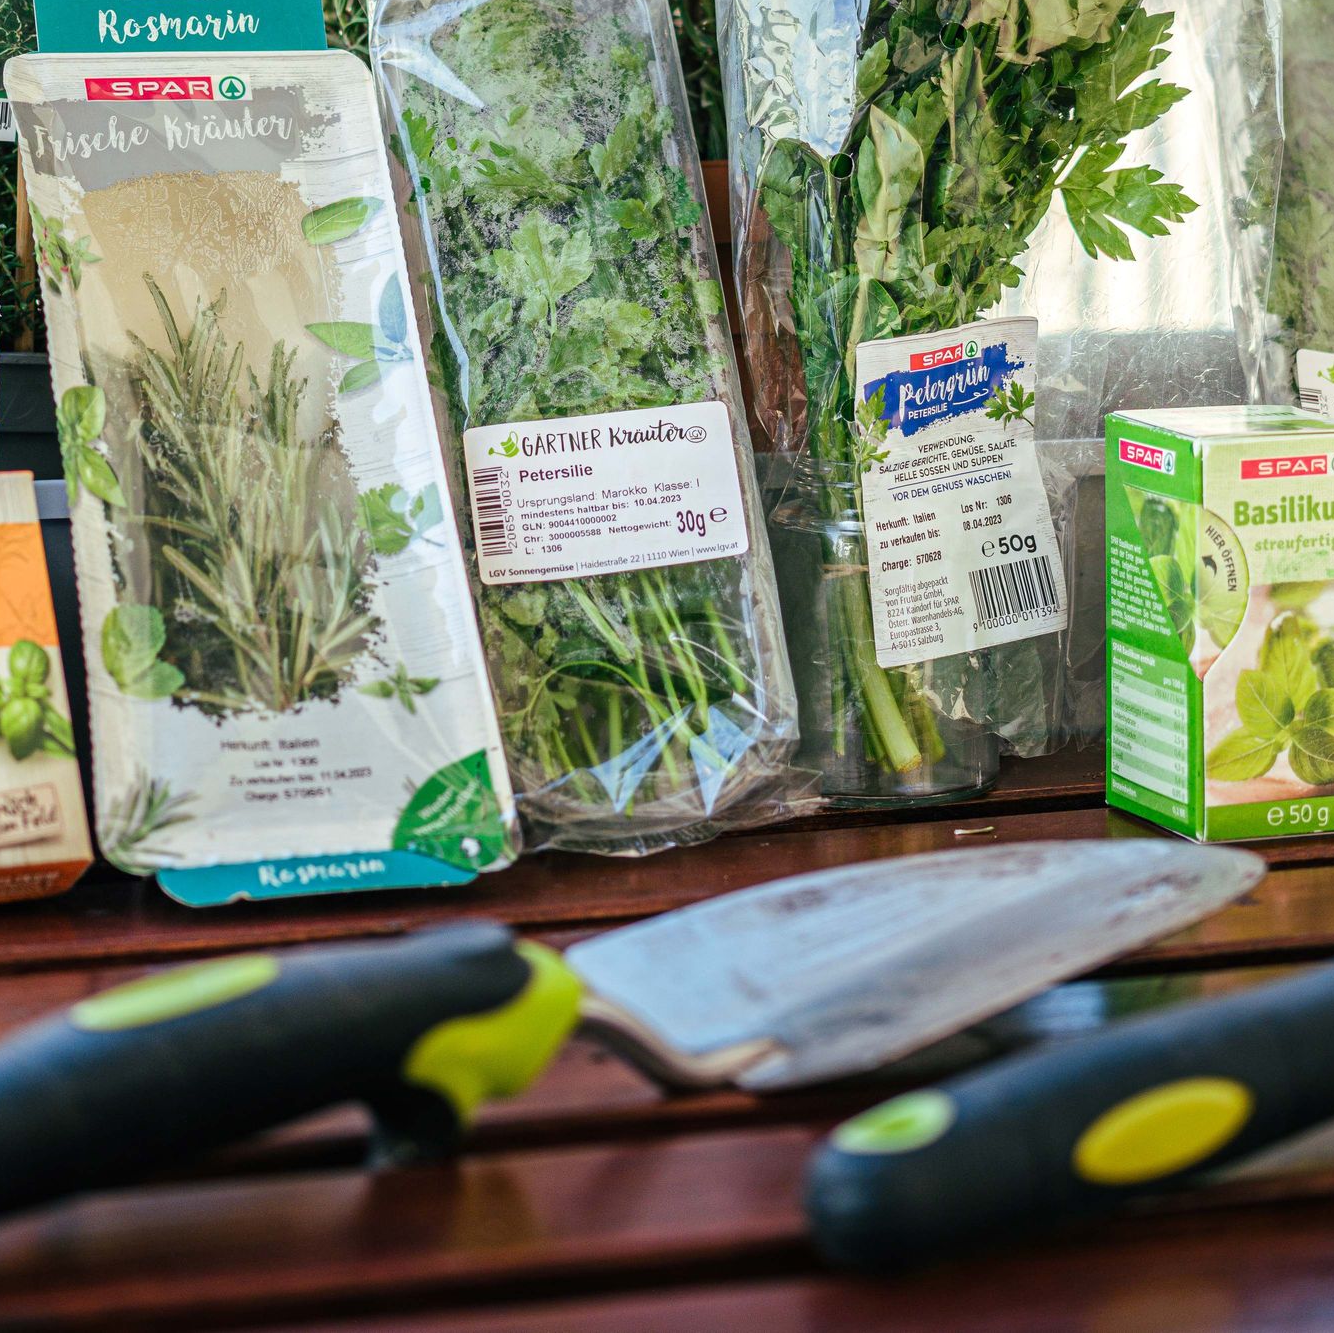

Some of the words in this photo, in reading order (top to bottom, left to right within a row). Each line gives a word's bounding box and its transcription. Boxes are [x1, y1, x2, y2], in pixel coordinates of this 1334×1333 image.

[98, 8, 260, 44] Rosmarin
[111, 80, 211, 97] SPAR
[33, 115, 149, 162] Frische
[163, 106, 293, 151] Kräuter
[922, 346, 962, 366] SPAR
[899, 361, 992, 423] Petergrün
[908, 402, 948, 421] PETERSILIE
[521, 428, 602, 457] GÄRTNER
[608, 419, 688, 448] Kräuter
[917, 434, 976, 454] VERWENDUNG:
[879, 460, 910, 474] SALZIGE
[911, 452, 950, 469] GERICHTE,
[951, 444, 986, 461] GEMÜSE,
[987, 438, 1017, 452] SALATE,
[1126, 445, 1163, 467] SPAR
[519, 464, 593, 483] Petersilie
[894, 470, 918, 483] HELLE
[919, 464, 951, 478] SOSSEN
[952, 460, 969, 471] UND
[970, 454, 1004, 468] SUPPEN
[1257, 458, 1327, 476] SPAR
[517, 491, 598, 509] Ursprungsland:
[601, 486, 648, 500] Marokko
[654, 480, 693, 493] Klasse:
[892, 489, 909, 502] VOR
[911, 485, 929, 497] DEM
[931, 479, 964, 494] GENUSS
[965, 470, 1013, 486] WASCHEN!
[520, 508, 575, 521] mindestens
[577, 503, 609, 514] haltbar
[612, 501, 629, 510] bis:
[634, 494, 682, 507] 10.04.2023
[960, 503, 974, 514] Los
[996, 494, 1012, 507] 1306
[522, 522, 546, 531] GLN:
[548, 529, 602, 541] 3000005588
[608, 520, 672, 534] Nettogewicht:
[676, 509, 706, 537] 30g
[875, 518, 910, 532] Herkunft:
[912, 511, 937, 524] Italien
[542, 544, 563, 554] 1306
[879, 541, 889, 550] zu
[890, 531, 926, 547] verkaufen
[927, 528, 941, 539] bis:
[998, 534, 1038, 555] 50g
[489, 568, 506, 578] LGV
[508, 563, 575, 576] Sonnengemüse
[580, 556, 629, 570] Haidestraße
[630, 554, 641, 564] 22
[647, 551, 667, 561] 1110
[668, 548, 690, 559] Wien
[696, 541, 739, 554] www.lgv.at
[881, 558, 913, 572] Charge:
[916, 550, 942, 565] 570628
[1205, 524, 1226, 550] HIER
[1221, 549, 1237, 592] ÖFFNEN
[884, 582, 917, 597] Sorgfältig
[917, 576, 949, 592] abgepackt
[885, 598, 899, 607] von
[944, 595, 960, 607] SPAR
[890, 623, 934, 641] Europastrasse
[891, 639, 917, 651] A-5015
[918, 632, 944, 646] Salzburg
[1288, 803, 1312, 823] 50
[257, 857, 386, 887] Rosmarin
